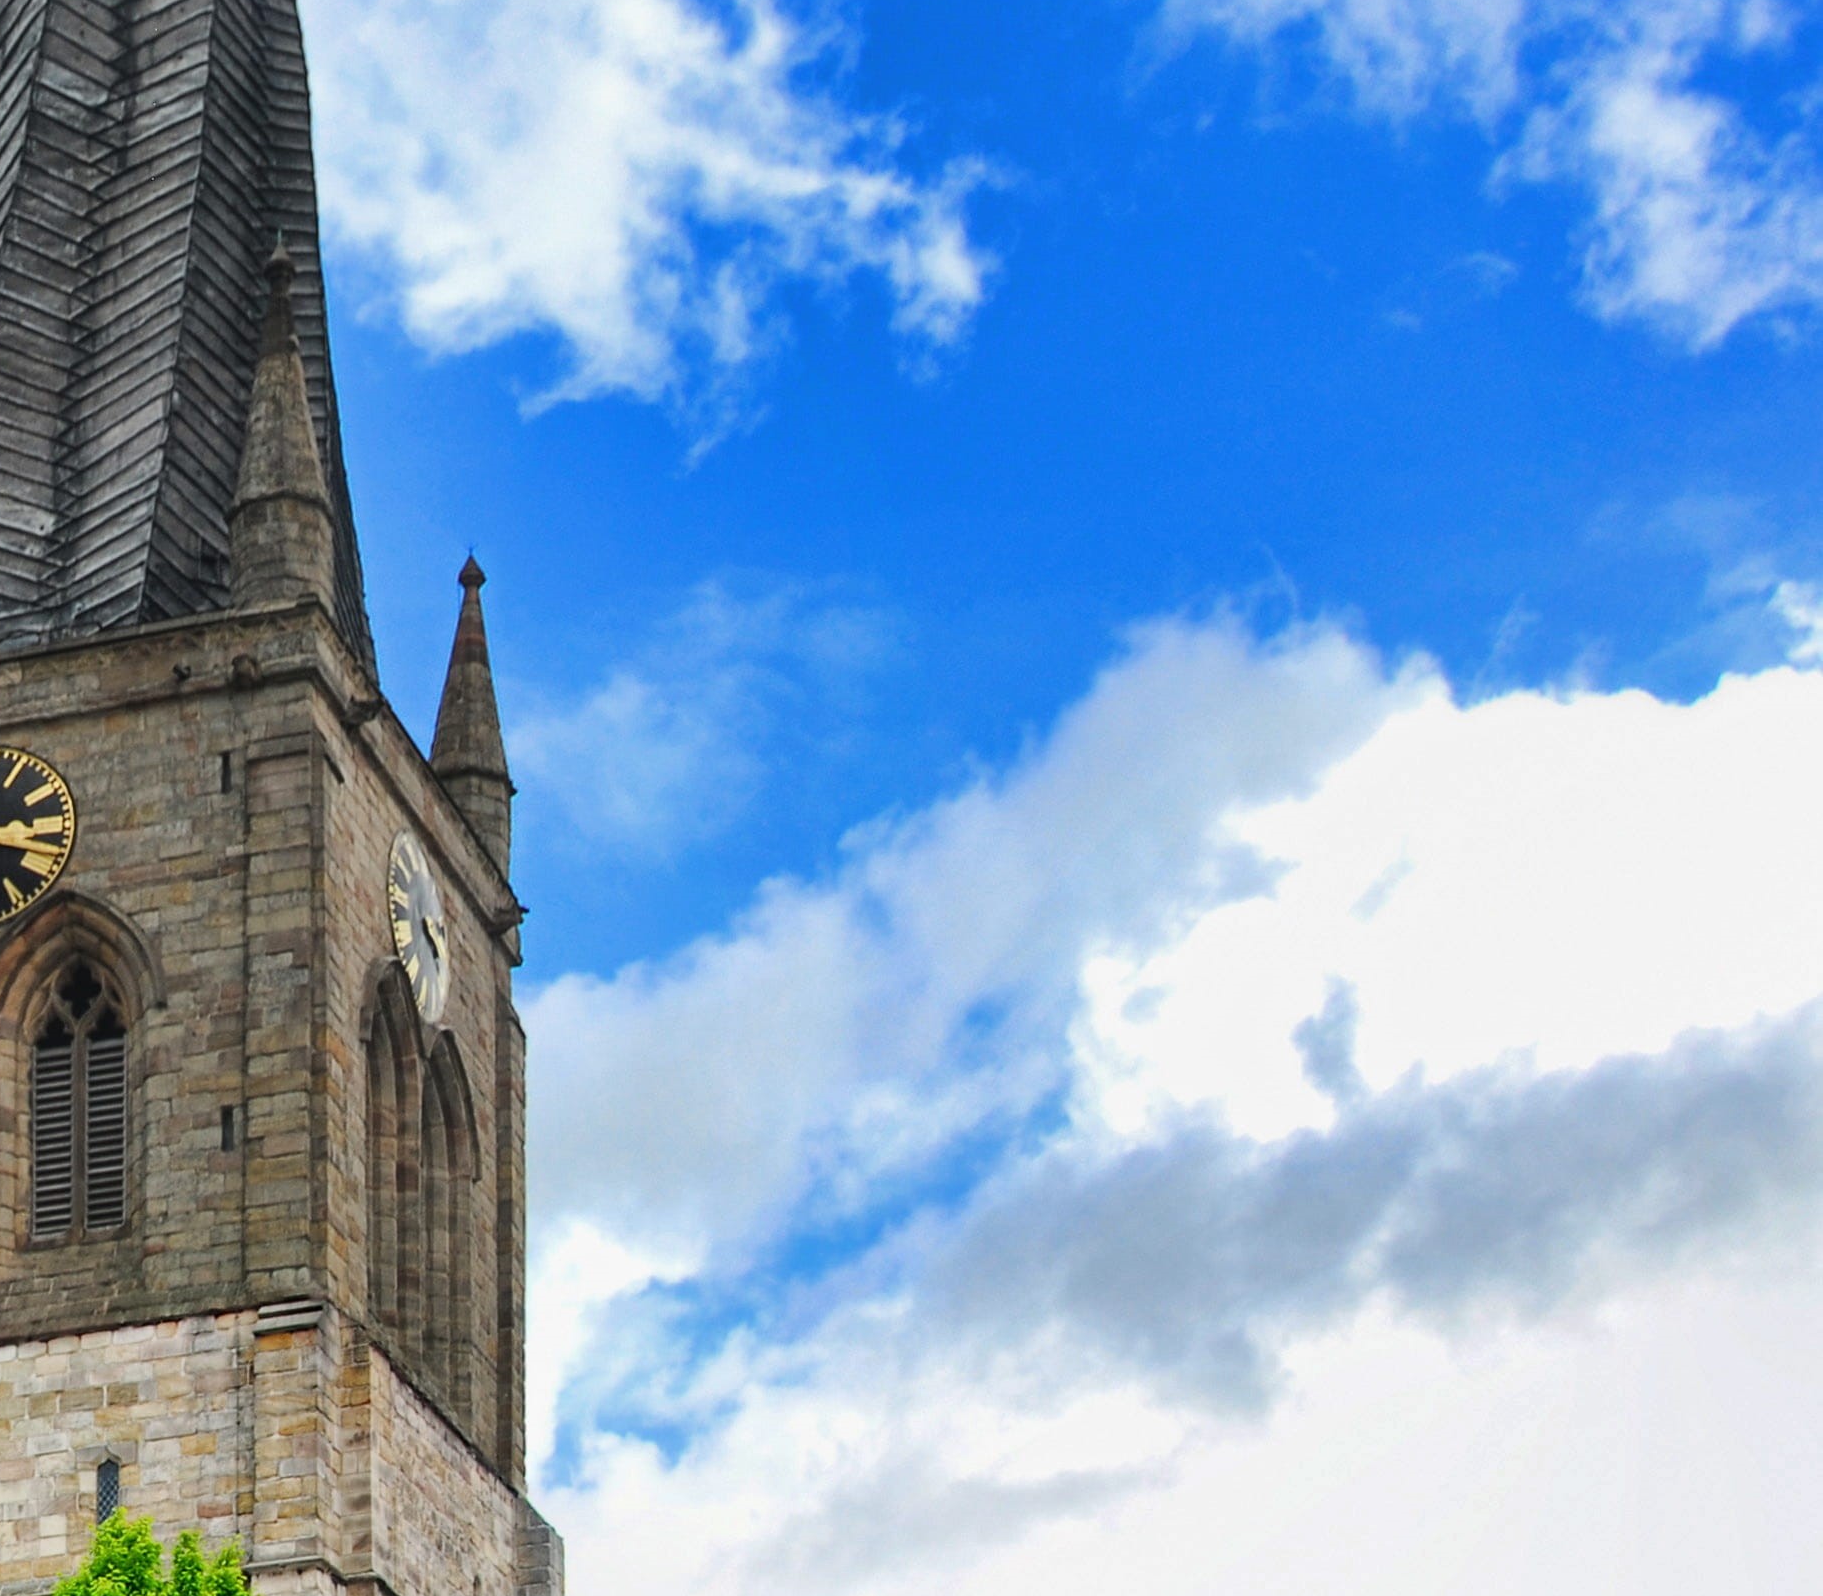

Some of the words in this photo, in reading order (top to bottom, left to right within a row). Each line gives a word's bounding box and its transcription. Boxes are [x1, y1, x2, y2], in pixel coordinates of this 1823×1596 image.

[3, 756, 27, 788] I
[24, 782, 55, 807] II
[33, 816, 63, 835] III
[3, 877, 24, 904] V
